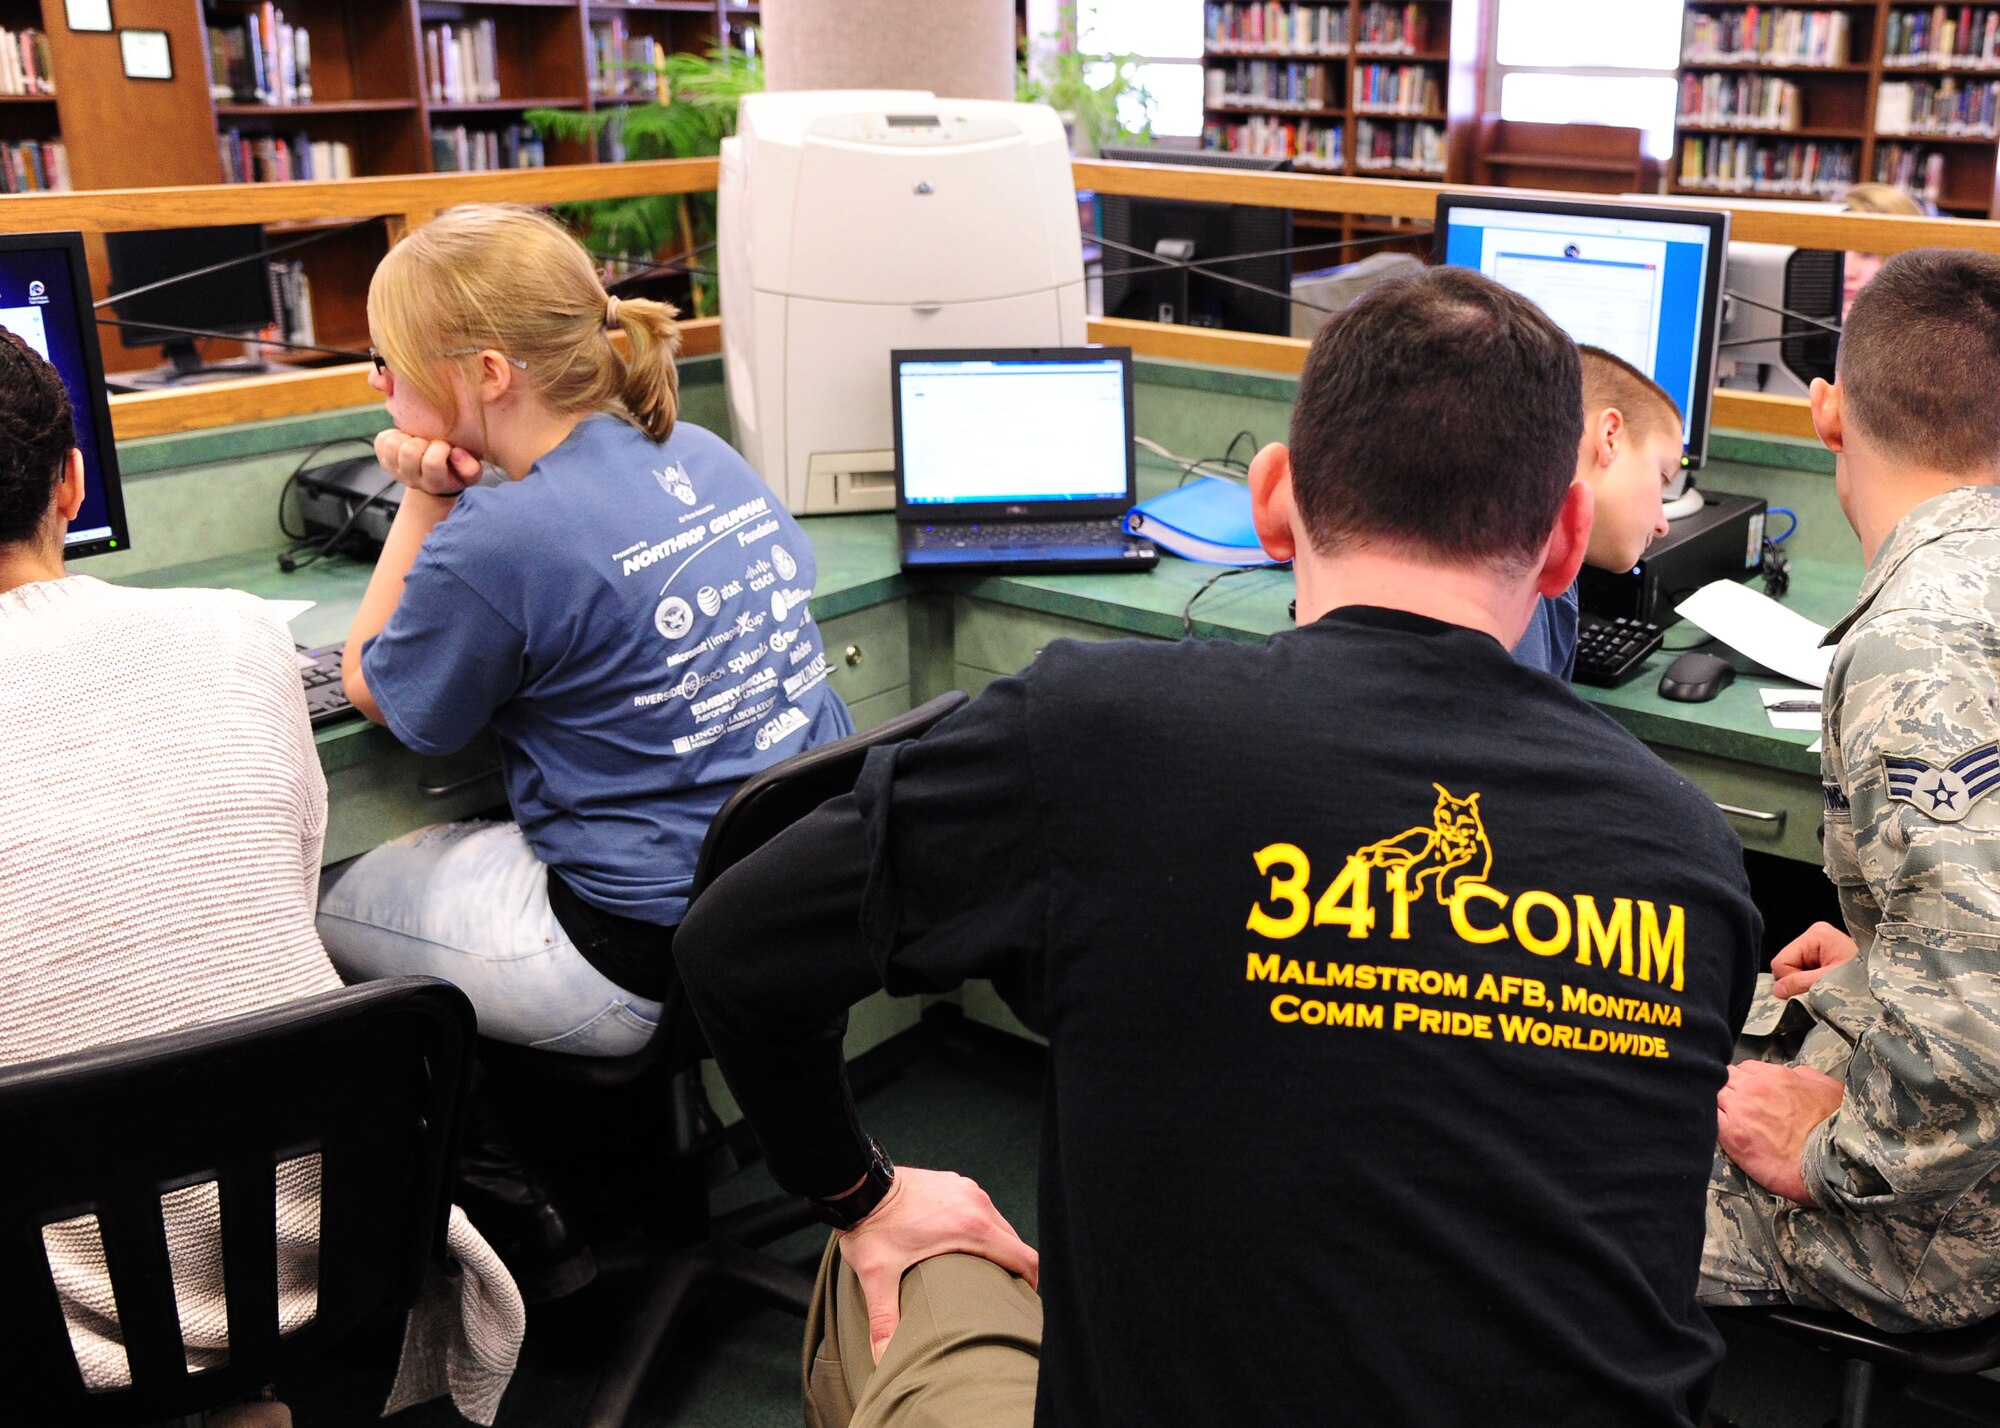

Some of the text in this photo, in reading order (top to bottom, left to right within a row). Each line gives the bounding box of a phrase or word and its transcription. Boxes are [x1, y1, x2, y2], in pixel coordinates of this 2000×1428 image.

[622, 496, 767, 577] NORTHROP GRUMMAN
[736, 519, 780, 547] Foundation
[720, 580, 743, 600] at&t
[634, 683, 683, 707] RIVERSIDE
[690, 667, 777, 716] EMBRYDLE
[690, 722, 726, 742] LINCO
[729, 695, 777, 724] LABORATO
[1245, 842, 1685, 992] 341 COMM
[1245, 952, 1682, 1028] MALMSTROM AFB, MONTANA
[1270, 994, 1669, 1059] COMM PRIDE WORLDWIDE
